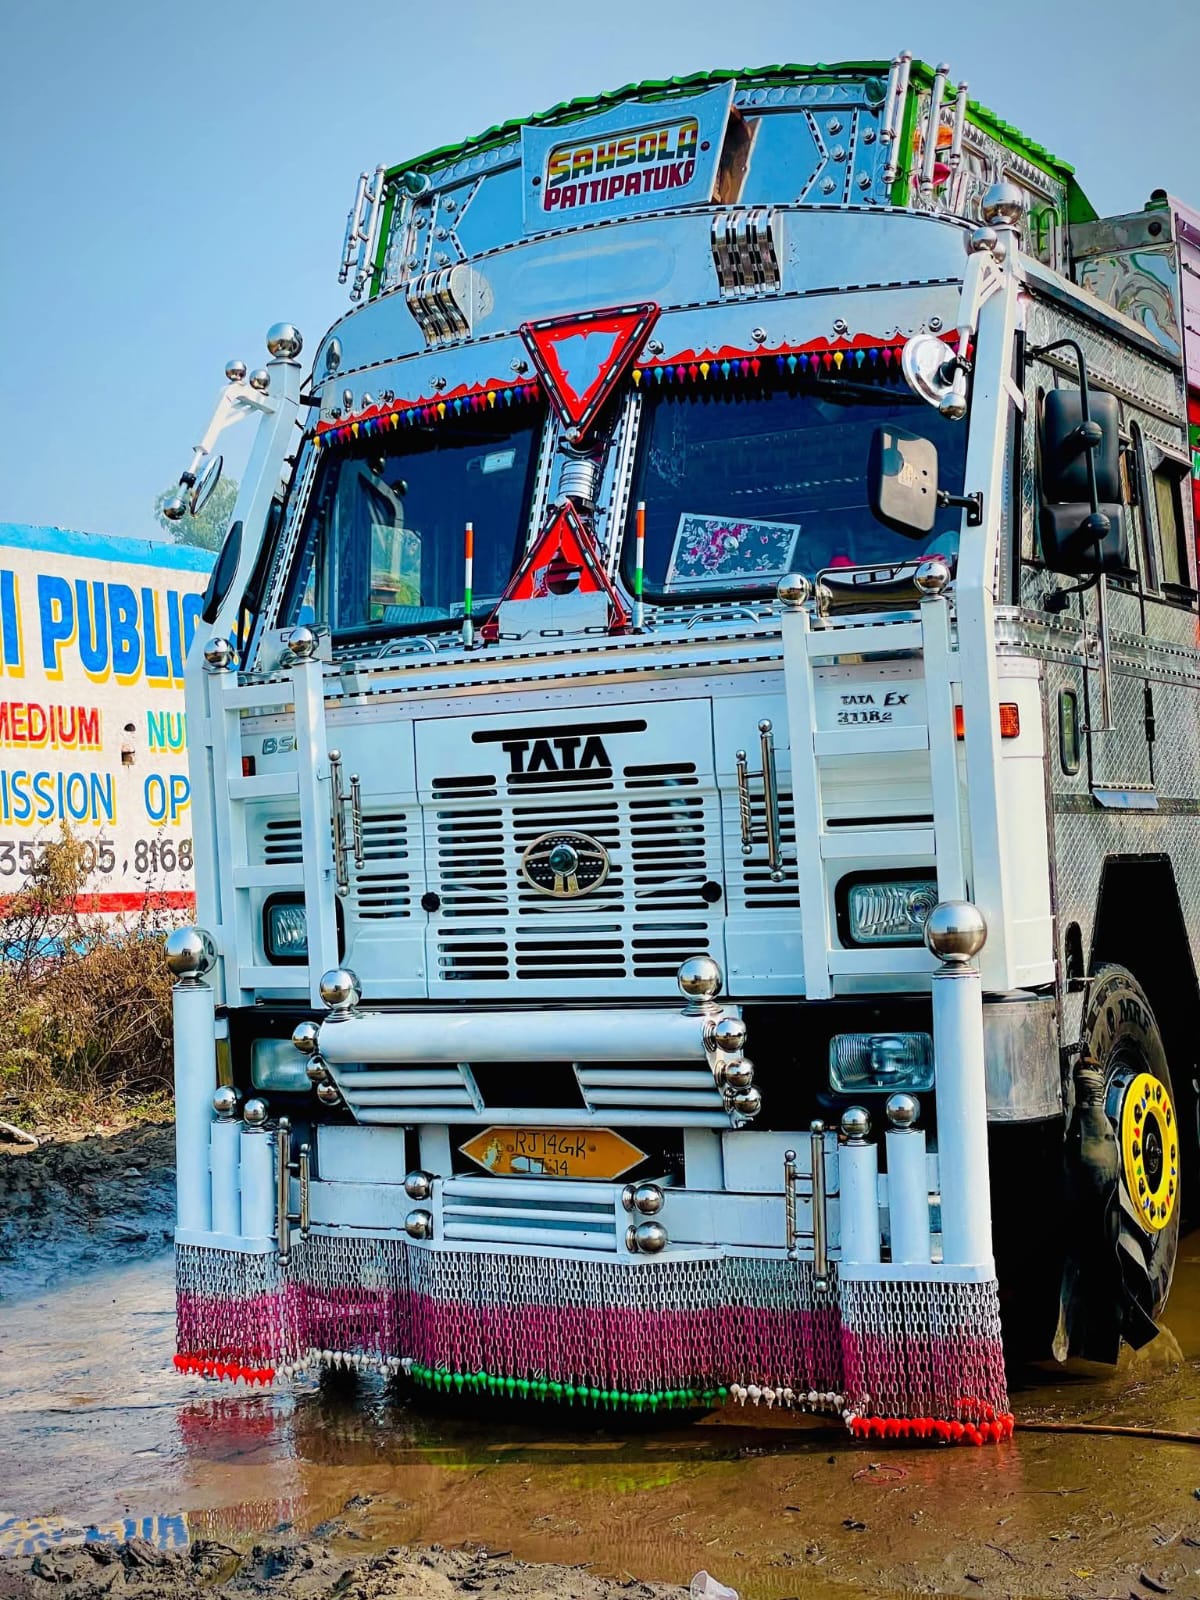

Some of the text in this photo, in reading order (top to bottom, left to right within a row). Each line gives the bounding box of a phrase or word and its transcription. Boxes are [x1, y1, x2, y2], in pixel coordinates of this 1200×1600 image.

[549, 122, 698, 188] SAHSOLA
[842, 694, 875, 706] TATA
[146, 710, 188, 748] NU
[502, 735, 612, 773] TATA
